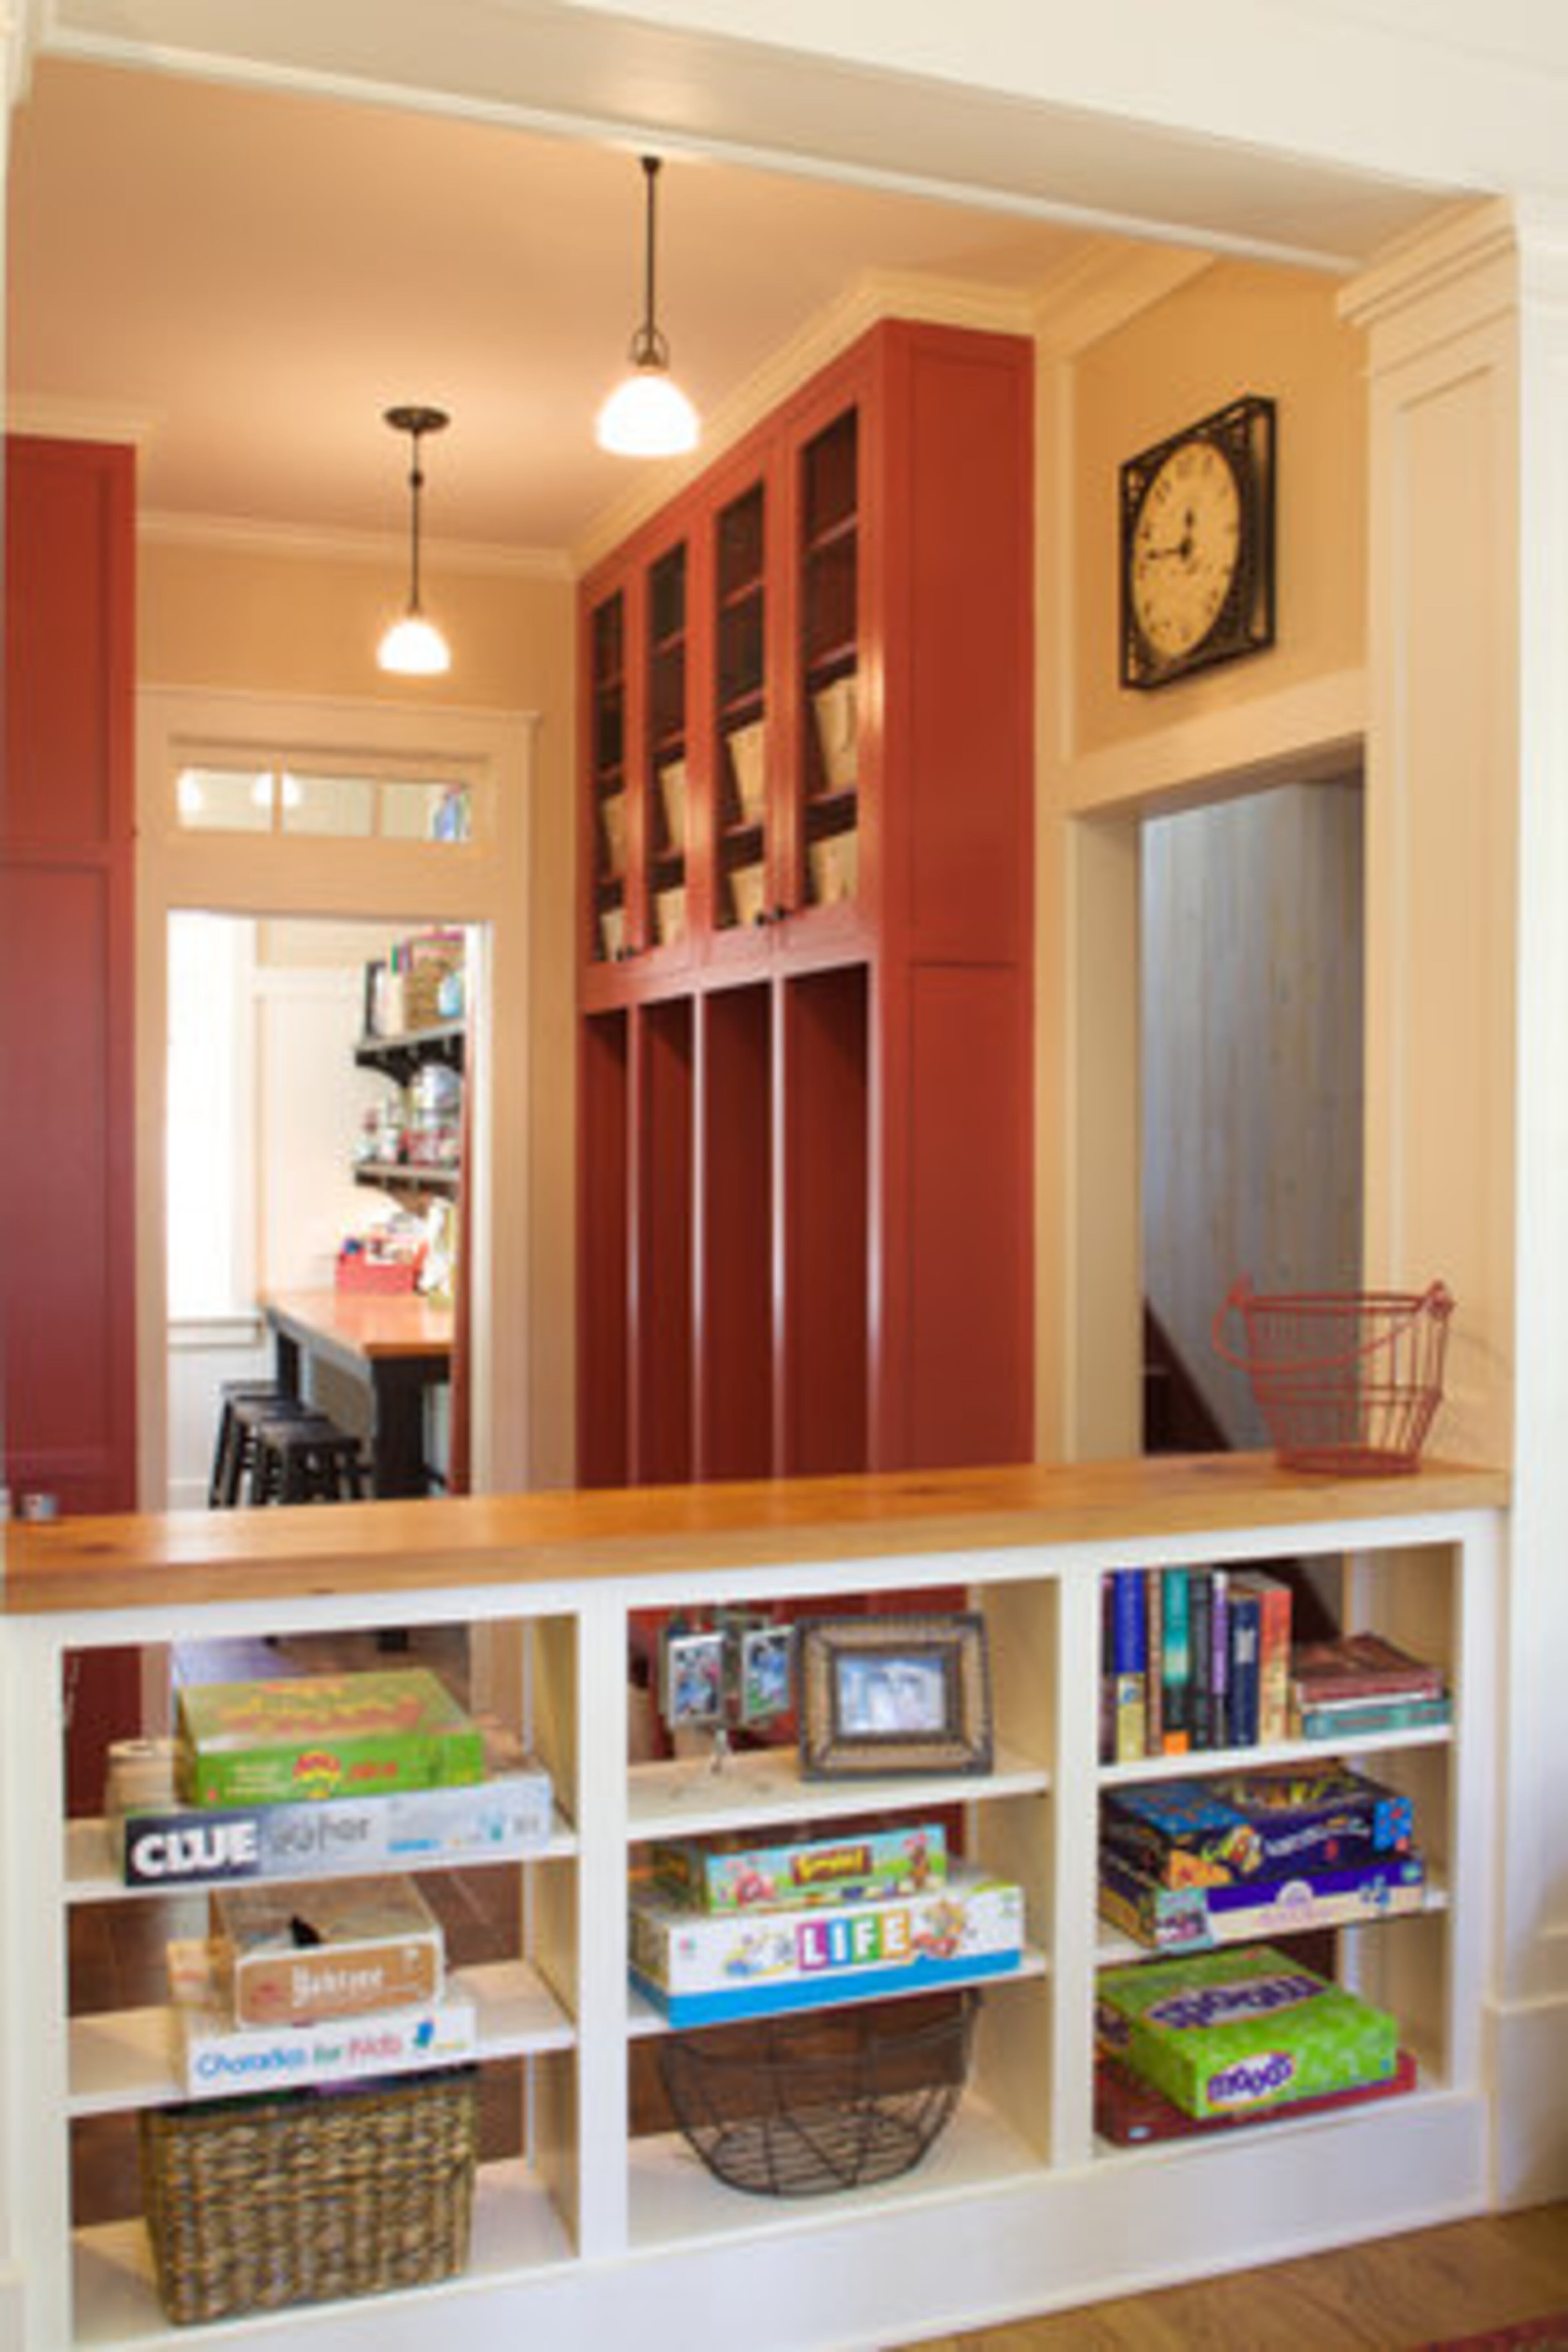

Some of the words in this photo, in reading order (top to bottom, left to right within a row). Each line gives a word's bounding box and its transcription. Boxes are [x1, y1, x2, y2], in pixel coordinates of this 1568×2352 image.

[132, 1819, 258, 1876] CLUE
[801, 1912, 908, 1967] LIFE
[197, 2047, 307, 2078] Charades
[313, 2045, 342, 2065] for
